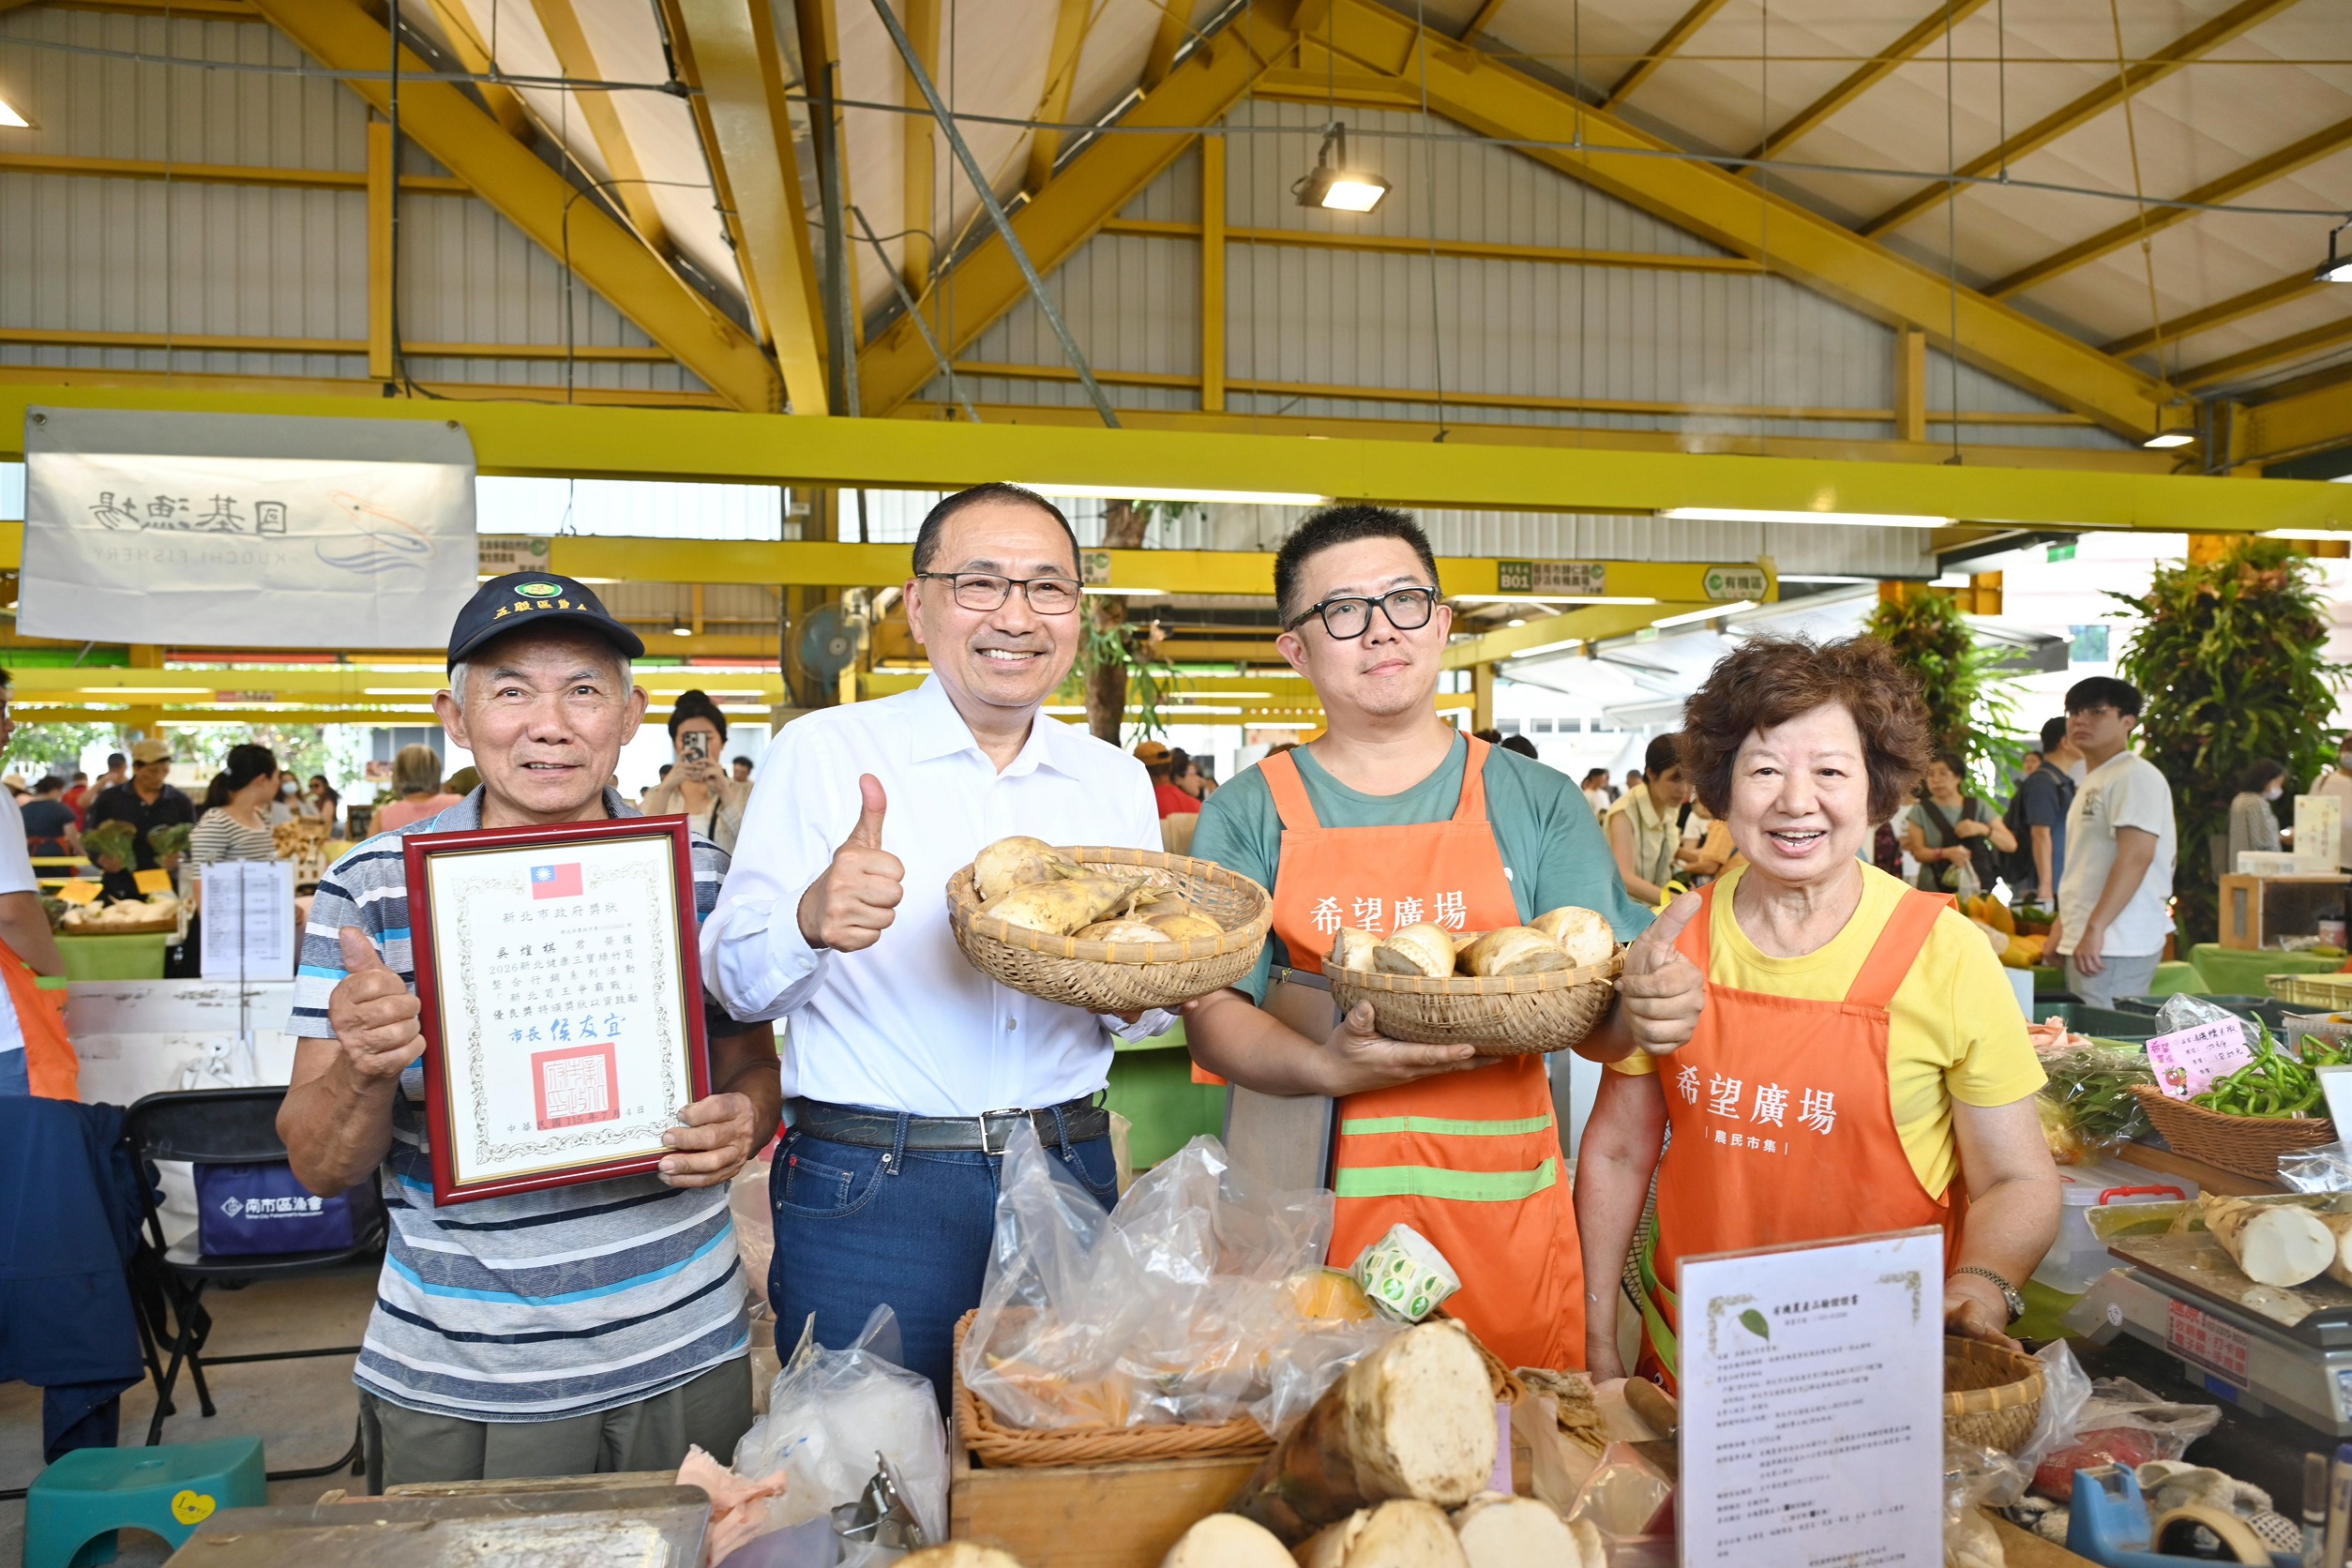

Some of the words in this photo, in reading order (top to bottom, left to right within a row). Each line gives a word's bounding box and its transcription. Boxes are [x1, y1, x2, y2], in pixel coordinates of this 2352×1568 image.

[1500, 575, 1530, 588] B01
[1725, 576, 1763, 590] 有機區
[503, 903, 619, 923] 新北市政府獎狀
[1310, 890, 1468, 935] 希望廣場
[508, 1026, 543, 1044] 市長
[550, 1012, 626, 1042] 侯友宜
[1676, 1063, 1838, 1135] 希望廣場
[1714, 1128, 1777, 1153] 農民市集
[245, 1195, 324, 1214] 南市區漁會
